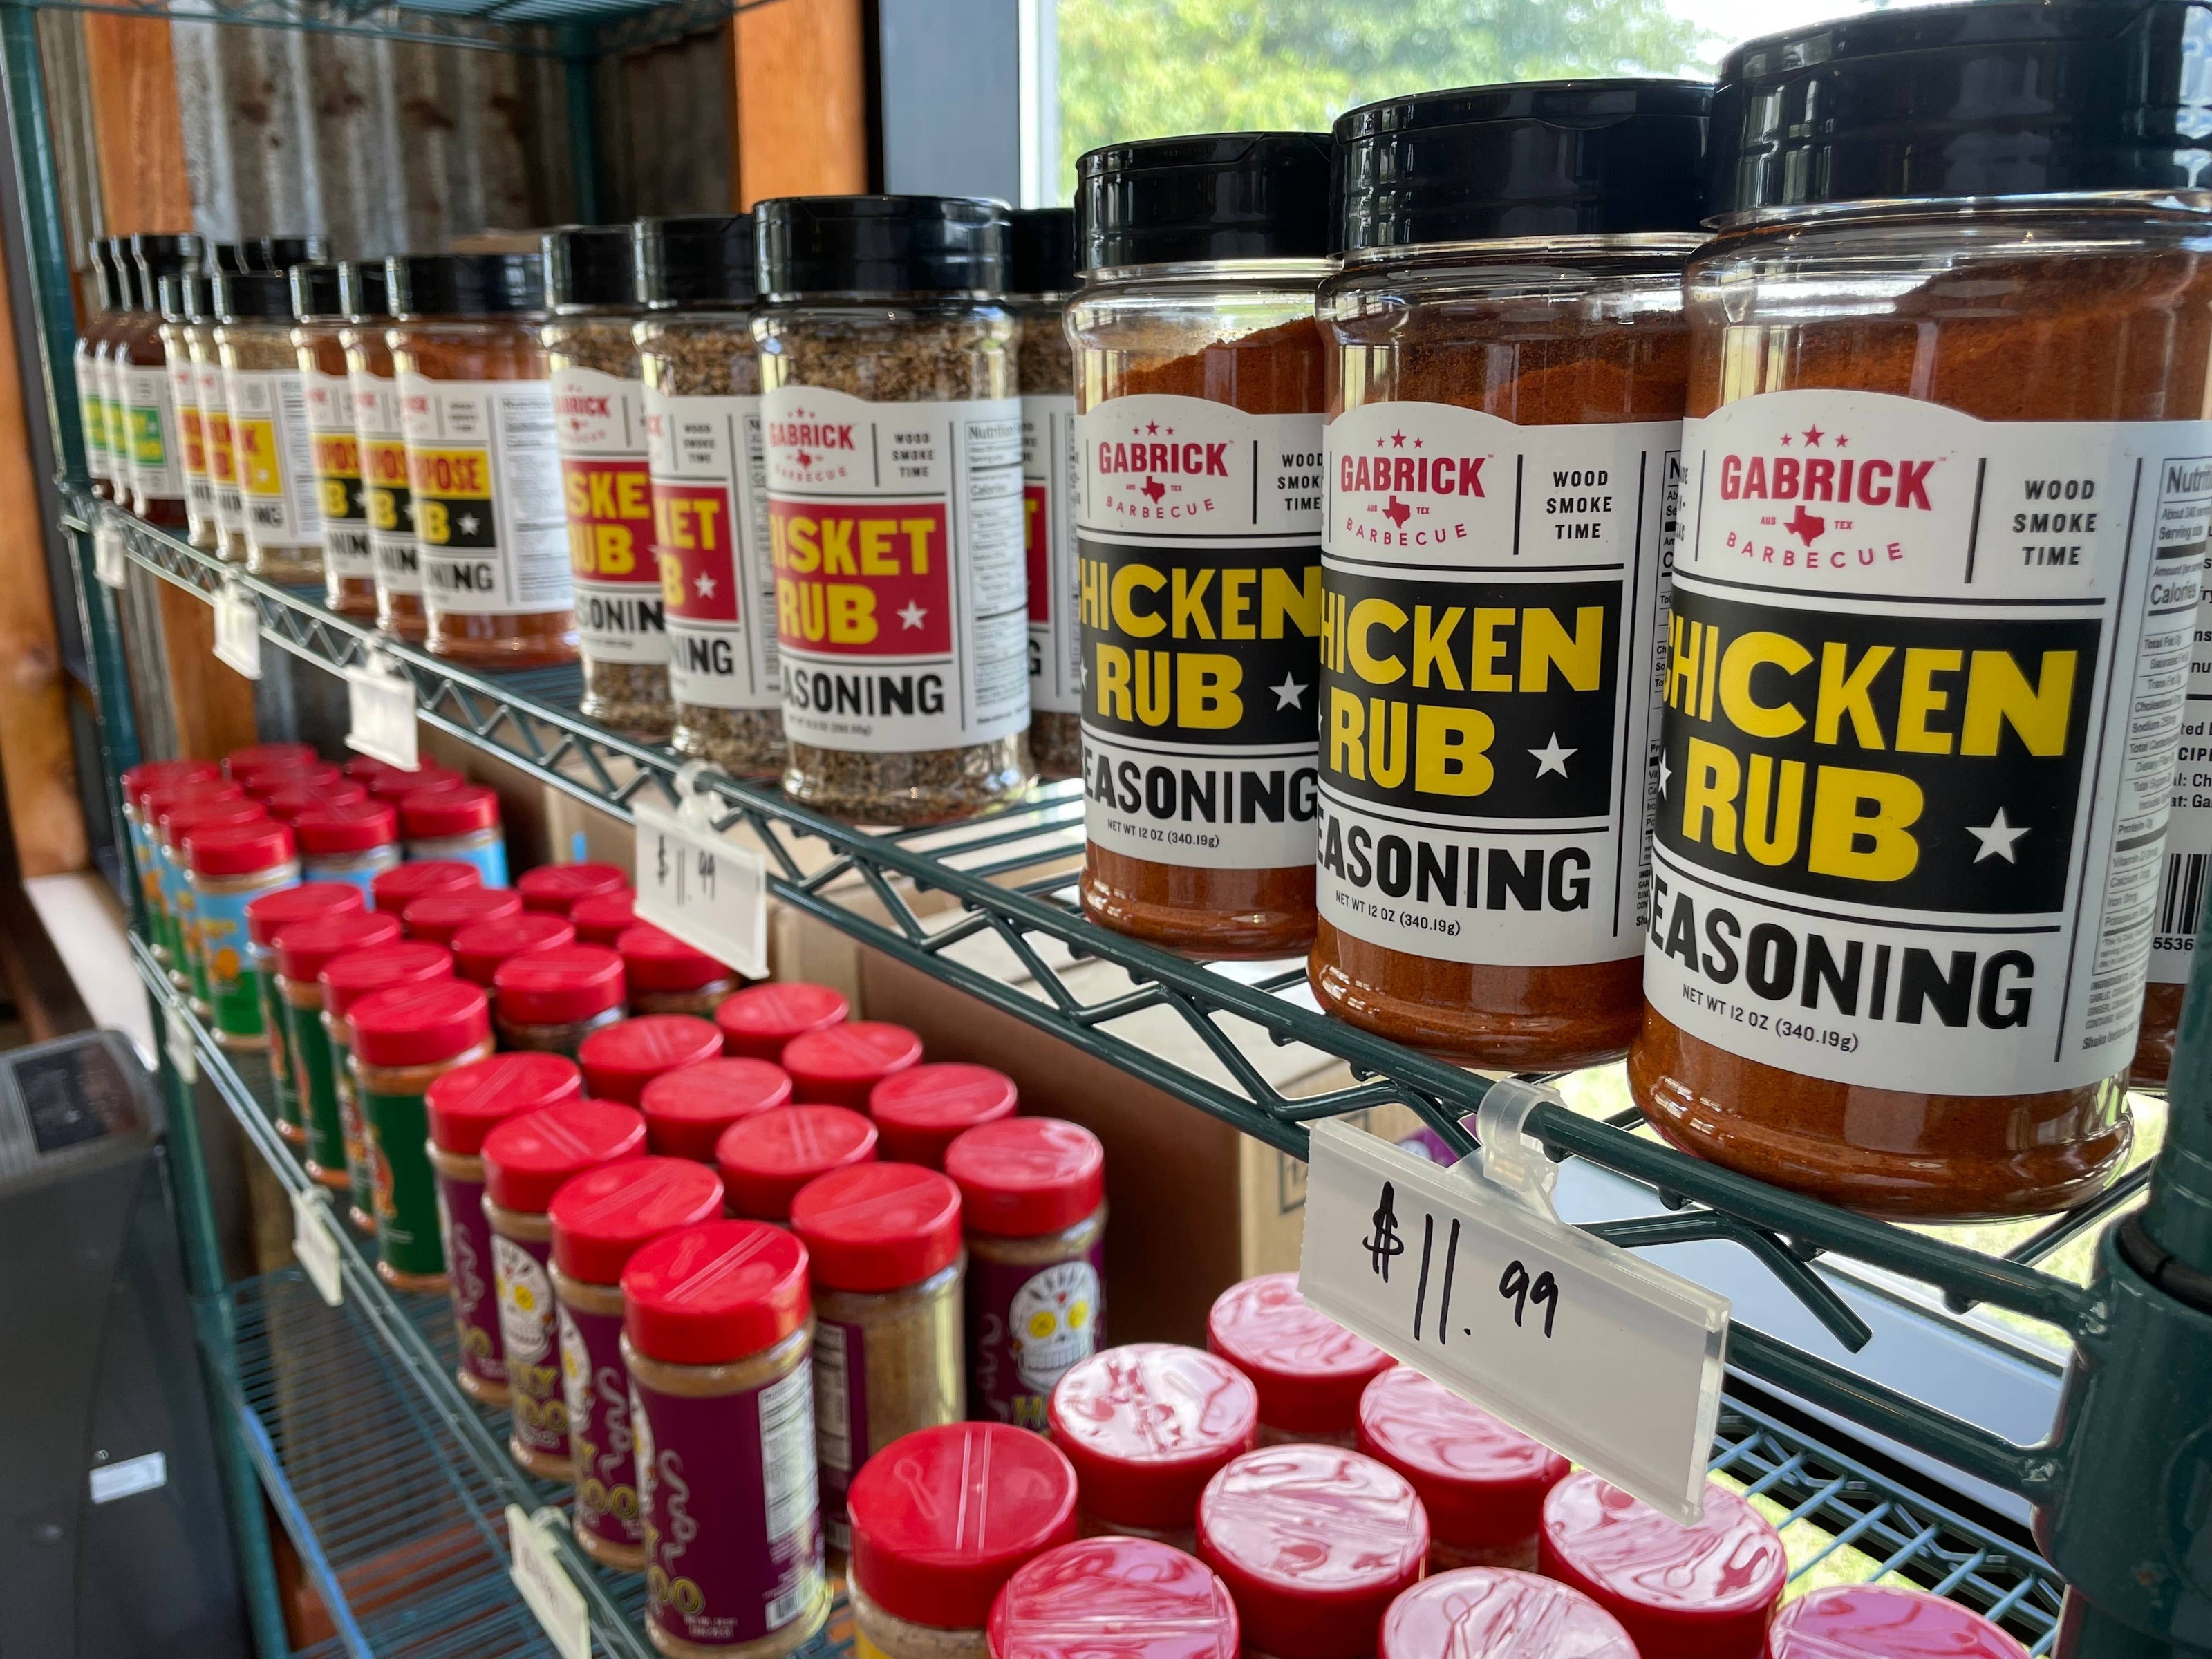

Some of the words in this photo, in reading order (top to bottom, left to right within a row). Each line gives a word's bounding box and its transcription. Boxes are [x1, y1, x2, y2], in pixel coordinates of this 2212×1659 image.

[892, 449, 935, 461] SMOKE
[894, 433, 930, 444] WOOD
[899, 466, 929, 478] TIME
[1099, 441, 1228, 477] GABRICK
[1282, 453, 1323, 467] WOOD
[1341, 453, 1486, 498] GABRICK
[1277, 475, 1323, 489] SMOK
[1553, 471, 1608, 487] WOOD
[1721, 453, 1936, 511] GABRICK
[2024, 480, 2095, 500] WOOD
[1107, 496, 1215, 519] BARBECUE
[1284, 496, 1320, 511] TIME
[1416, 506, 1430, 515] TEX
[1546, 496, 1613, 514] SMOKE
[1347, 517, 1468, 547] BARBECUE
[1555, 523, 1602, 540] TIME
[1760, 515, 1777, 526] AUS
[1834, 520, 1853, 531] TEX
[2012, 512, 2097, 534] SMOKE
[2158, 524, 2193, 541] Serving
[568, 521, 636, 575] UB
[769, 514, 936, 577] ISKET
[1726, 530, 1904, 570] BARBECUE
[2021, 546, 2081, 567] TIME
[1078, 557, 1322, 640] HICKEN
[2150, 581, 2197, 606] Calories
[777, 576, 879, 645] RUB
[1320, 588, 1604, 693] HICKEN
[782, 664, 945, 717] ASONING
[1096, 641, 1244, 729] RUB
[1329, 686, 1496, 797] RUB
[1083, 747, 1318, 824] EASONING
[1680, 736, 1924, 883] RUB
[1107, 818, 1121, 832] NET
[1123, 824, 1136, 836] WT
[1138, 827, 1147, 838] 12
[1150, 830, 1163, 841] OZ
[1168, 831, 1219, 848] (340.19g)
[1317, 805, 1591, 912] EASONING
[1335, 890, 1349, 907] NET
[1351, 897, 1365, 913] WT
[1368, 904, 1378, 917] 12
[1381, 908, 1395, 923] OZ
[1400, 911, 1461, 936] (340.19g)
[1647, 868, 2034, 1031] EASONING
[1683, 984, 1704, 1006] NET
[1707, 995, 1726, 1015] WT
[1730, 1004, 1743, 1022] 12
[1748, 1011, 1769, 1031] OZ
[1775, 1018, 1859, 1053] (340.19g)
[1362, 1181, 1559, 1345] $11.99
